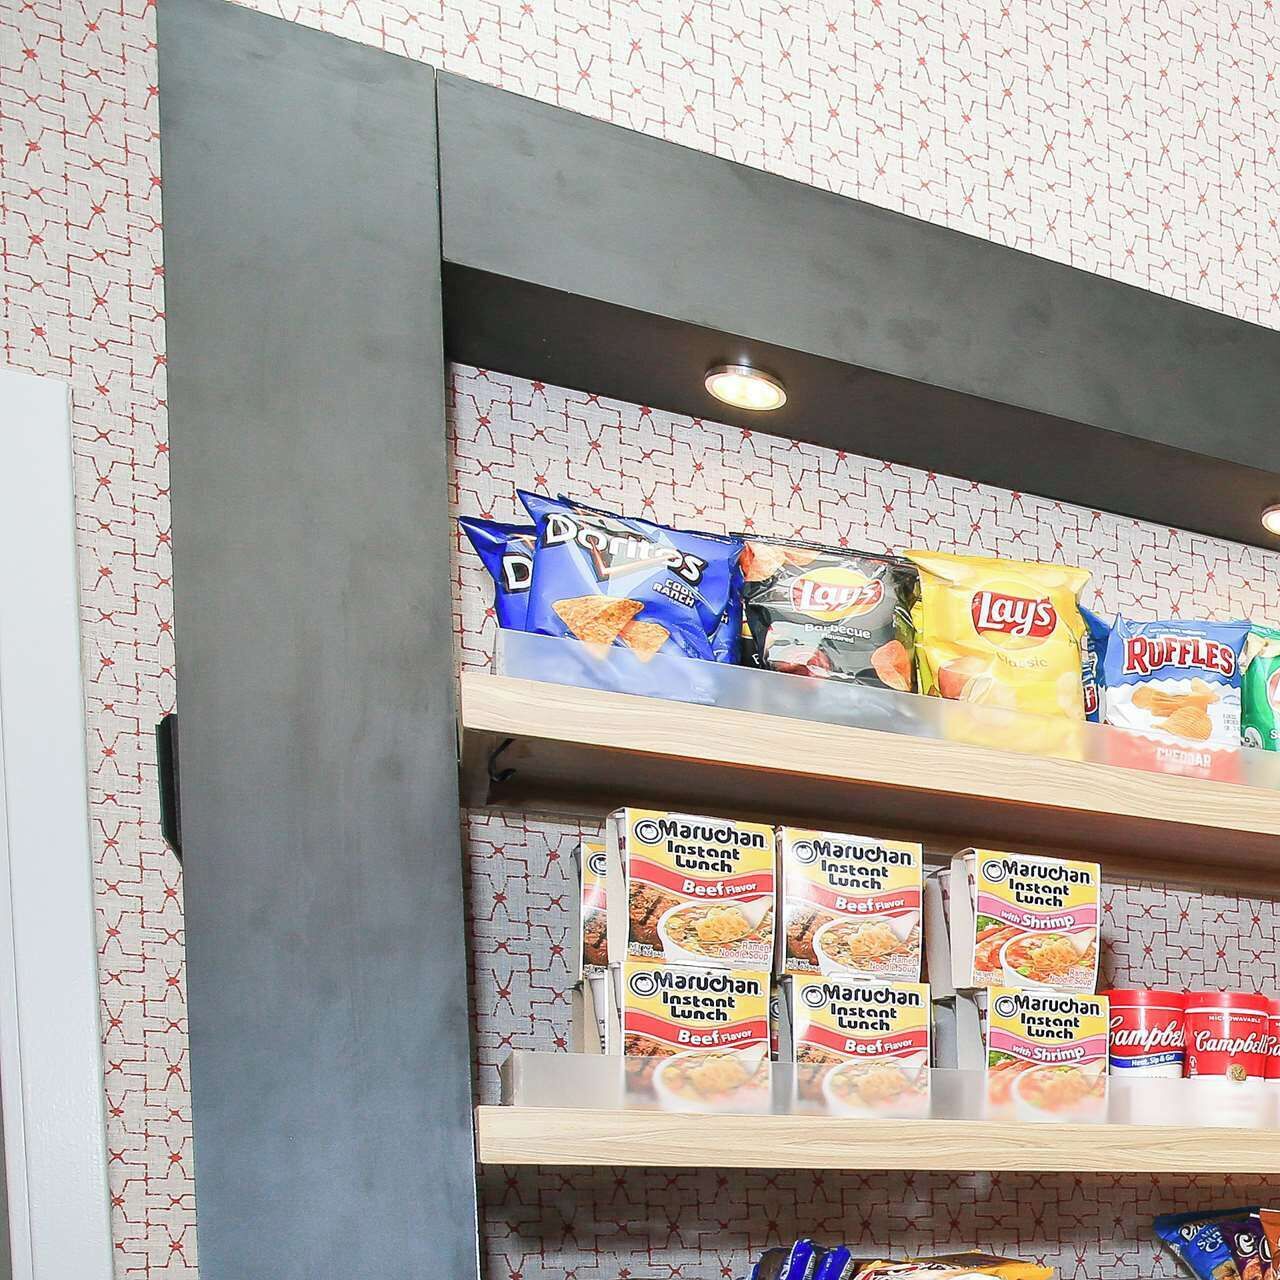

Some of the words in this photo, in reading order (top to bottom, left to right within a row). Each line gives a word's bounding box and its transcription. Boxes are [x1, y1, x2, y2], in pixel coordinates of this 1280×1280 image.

[544, 514, 704, 585] Doritos
[653, 583, 695, 607] RANCH
[977, 592, 1054, 637] Lay's
[804, 623, 871, 640] Barbecue
[1127, 637, 1234, 674] RUFFLES
[659, 820, 765, 848] Maruchan
[667, 840, 740, 860] Instant
[813, 840, 912, 866] Maruchan
[676, 855, 732, 873] Lunch
[821, 859, 888, 878] Instant
[1003, 860, 1090, 884] Maruchan
[682, 880, 724, 896] Beef
[726, 882, 757, 895] Flavor
[829, 873, 882, 890] Lunch
[1009, 878, 1069, 895] Instant
[835, 897, 874, 912] Beef
[876, 898, 904, 911] Flavor
[1016, 892, 1063, 907] Lunch
[1001, 909, 1020, 922] with
[1022, 913, 1074, 929] Shrimp
[654, 971, 758, 994] Maruchan
[662, 992, 735, 1008] Instant
[823, 983, 920, 1006] Maruchan
[671, 1005, 728, 1021] Lunch
[831, 1003, 896, 1019] Instant
[1015, 995, 1100, 1016] Maruchan
[838, 1016, 890, 1031] Lunch
[1021, 1013, 1080, 1028] Instant
[678, 1030, 720, 1045] Beef
[721, 1029, 752, 1043] Flavor
[1027, 1026, 1073, 1040] Lunch
[844, 1039, 883, 1054] Beef
[885, 1038, 912, 1051] Flavor
[1012, 1044, 1031, 1057] with
[1033, 1045, 1084, 1060] Shrimp
